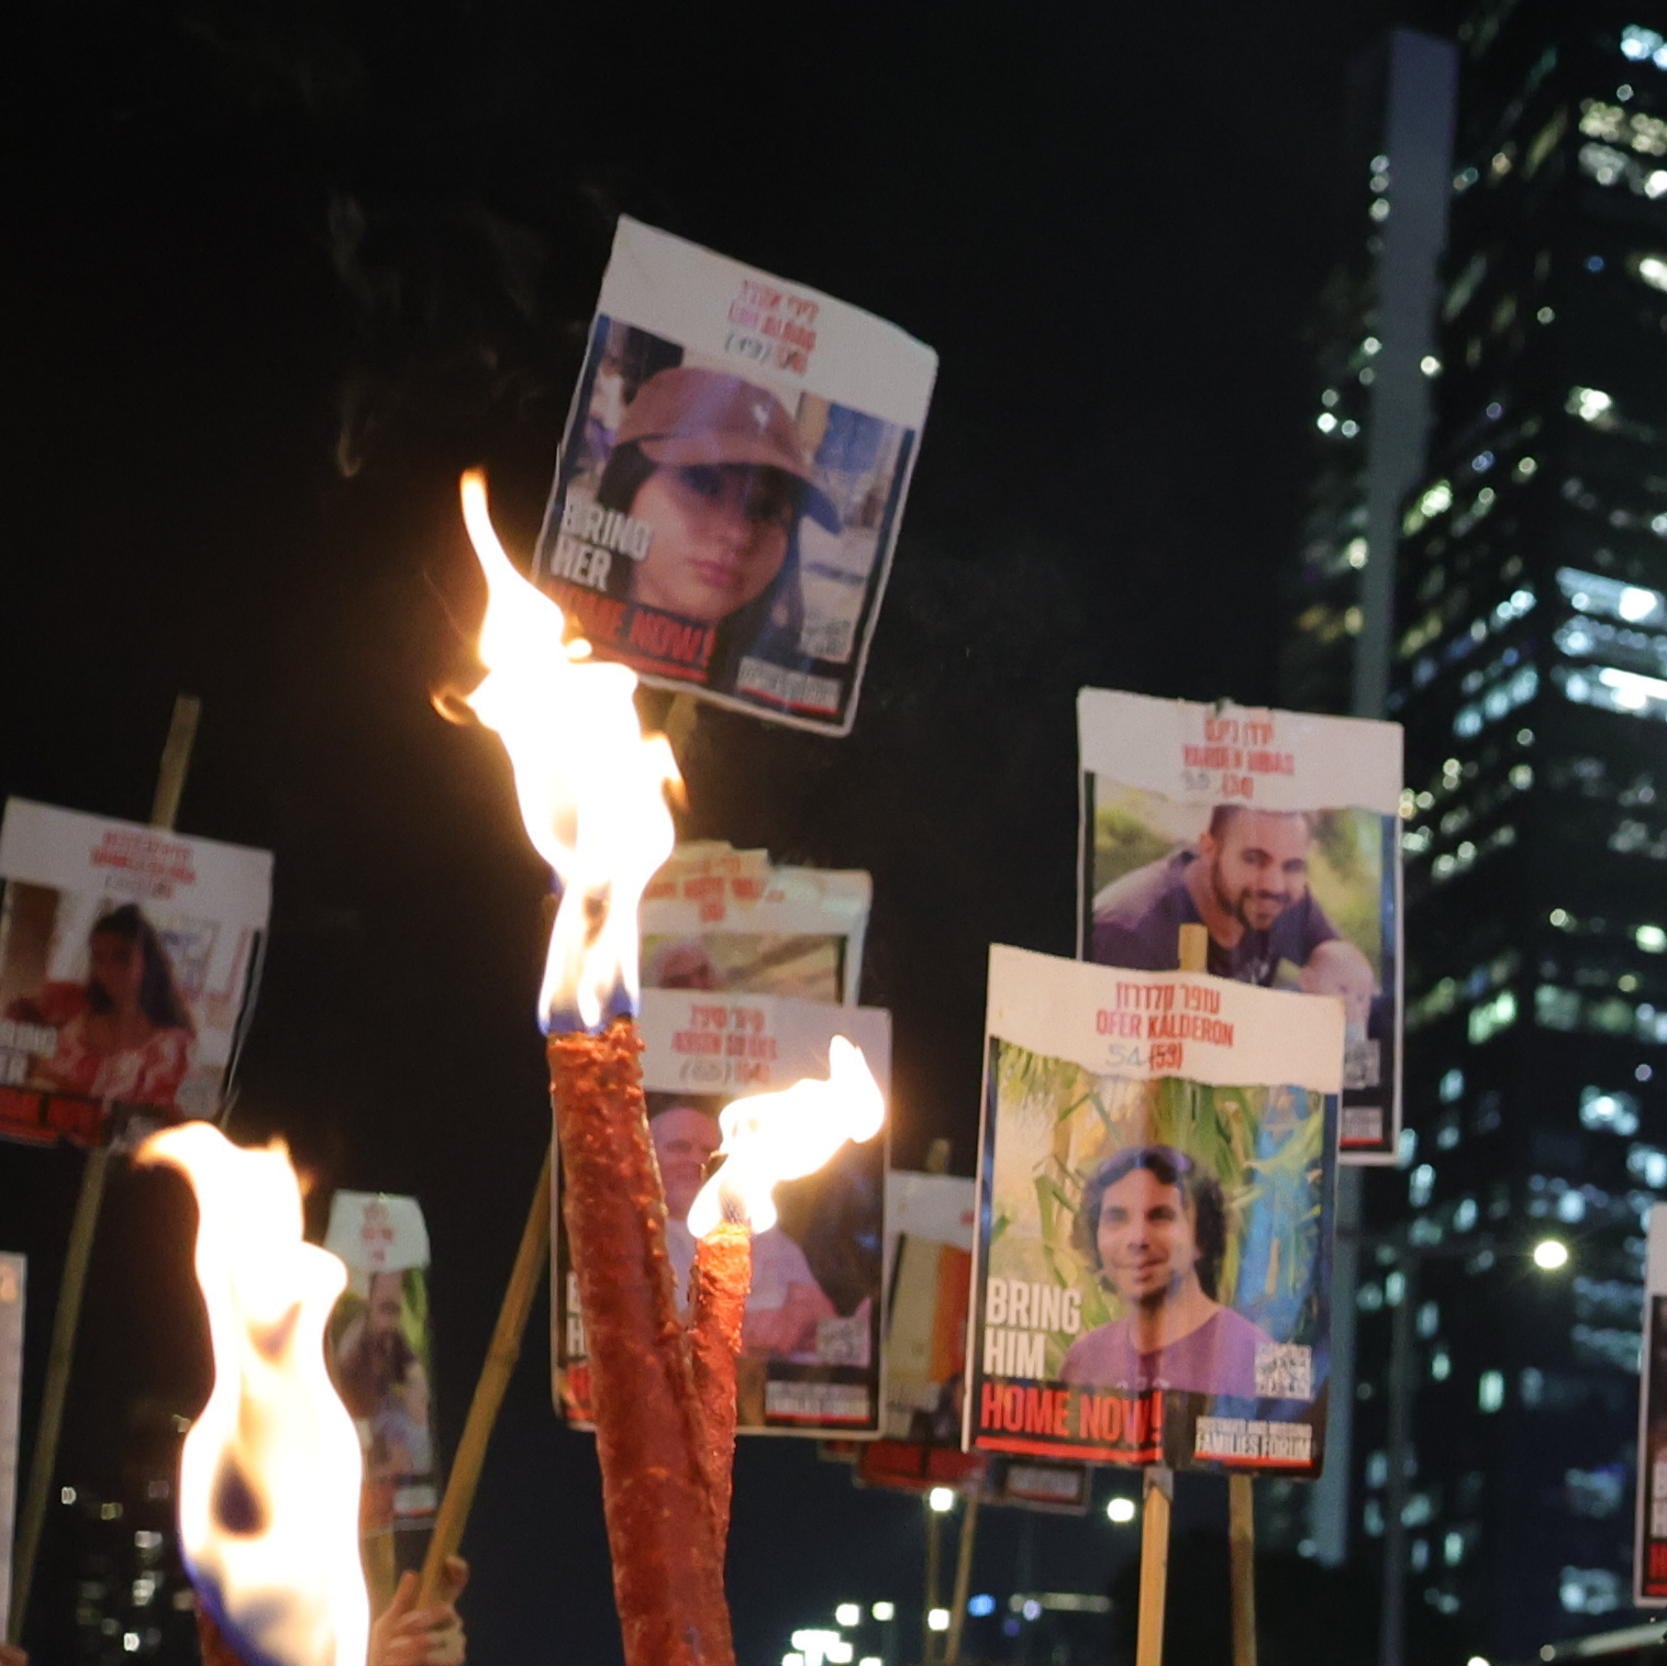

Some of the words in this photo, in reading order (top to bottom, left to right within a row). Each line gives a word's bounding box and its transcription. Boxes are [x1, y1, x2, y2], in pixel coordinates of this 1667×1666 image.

[550, 538, 612, 592] HER
[1096, 1009, 1142, 1038] OFER
[1147, 1012, 1235, 1048] KALDERON
[985, 1277, 1082, 1335] BRING
[983, 1326, 1046, 1378] HIM
[981, 1382, 1071, 1438] HOME
[1079, 1388, 1165, 1446] NOW!
